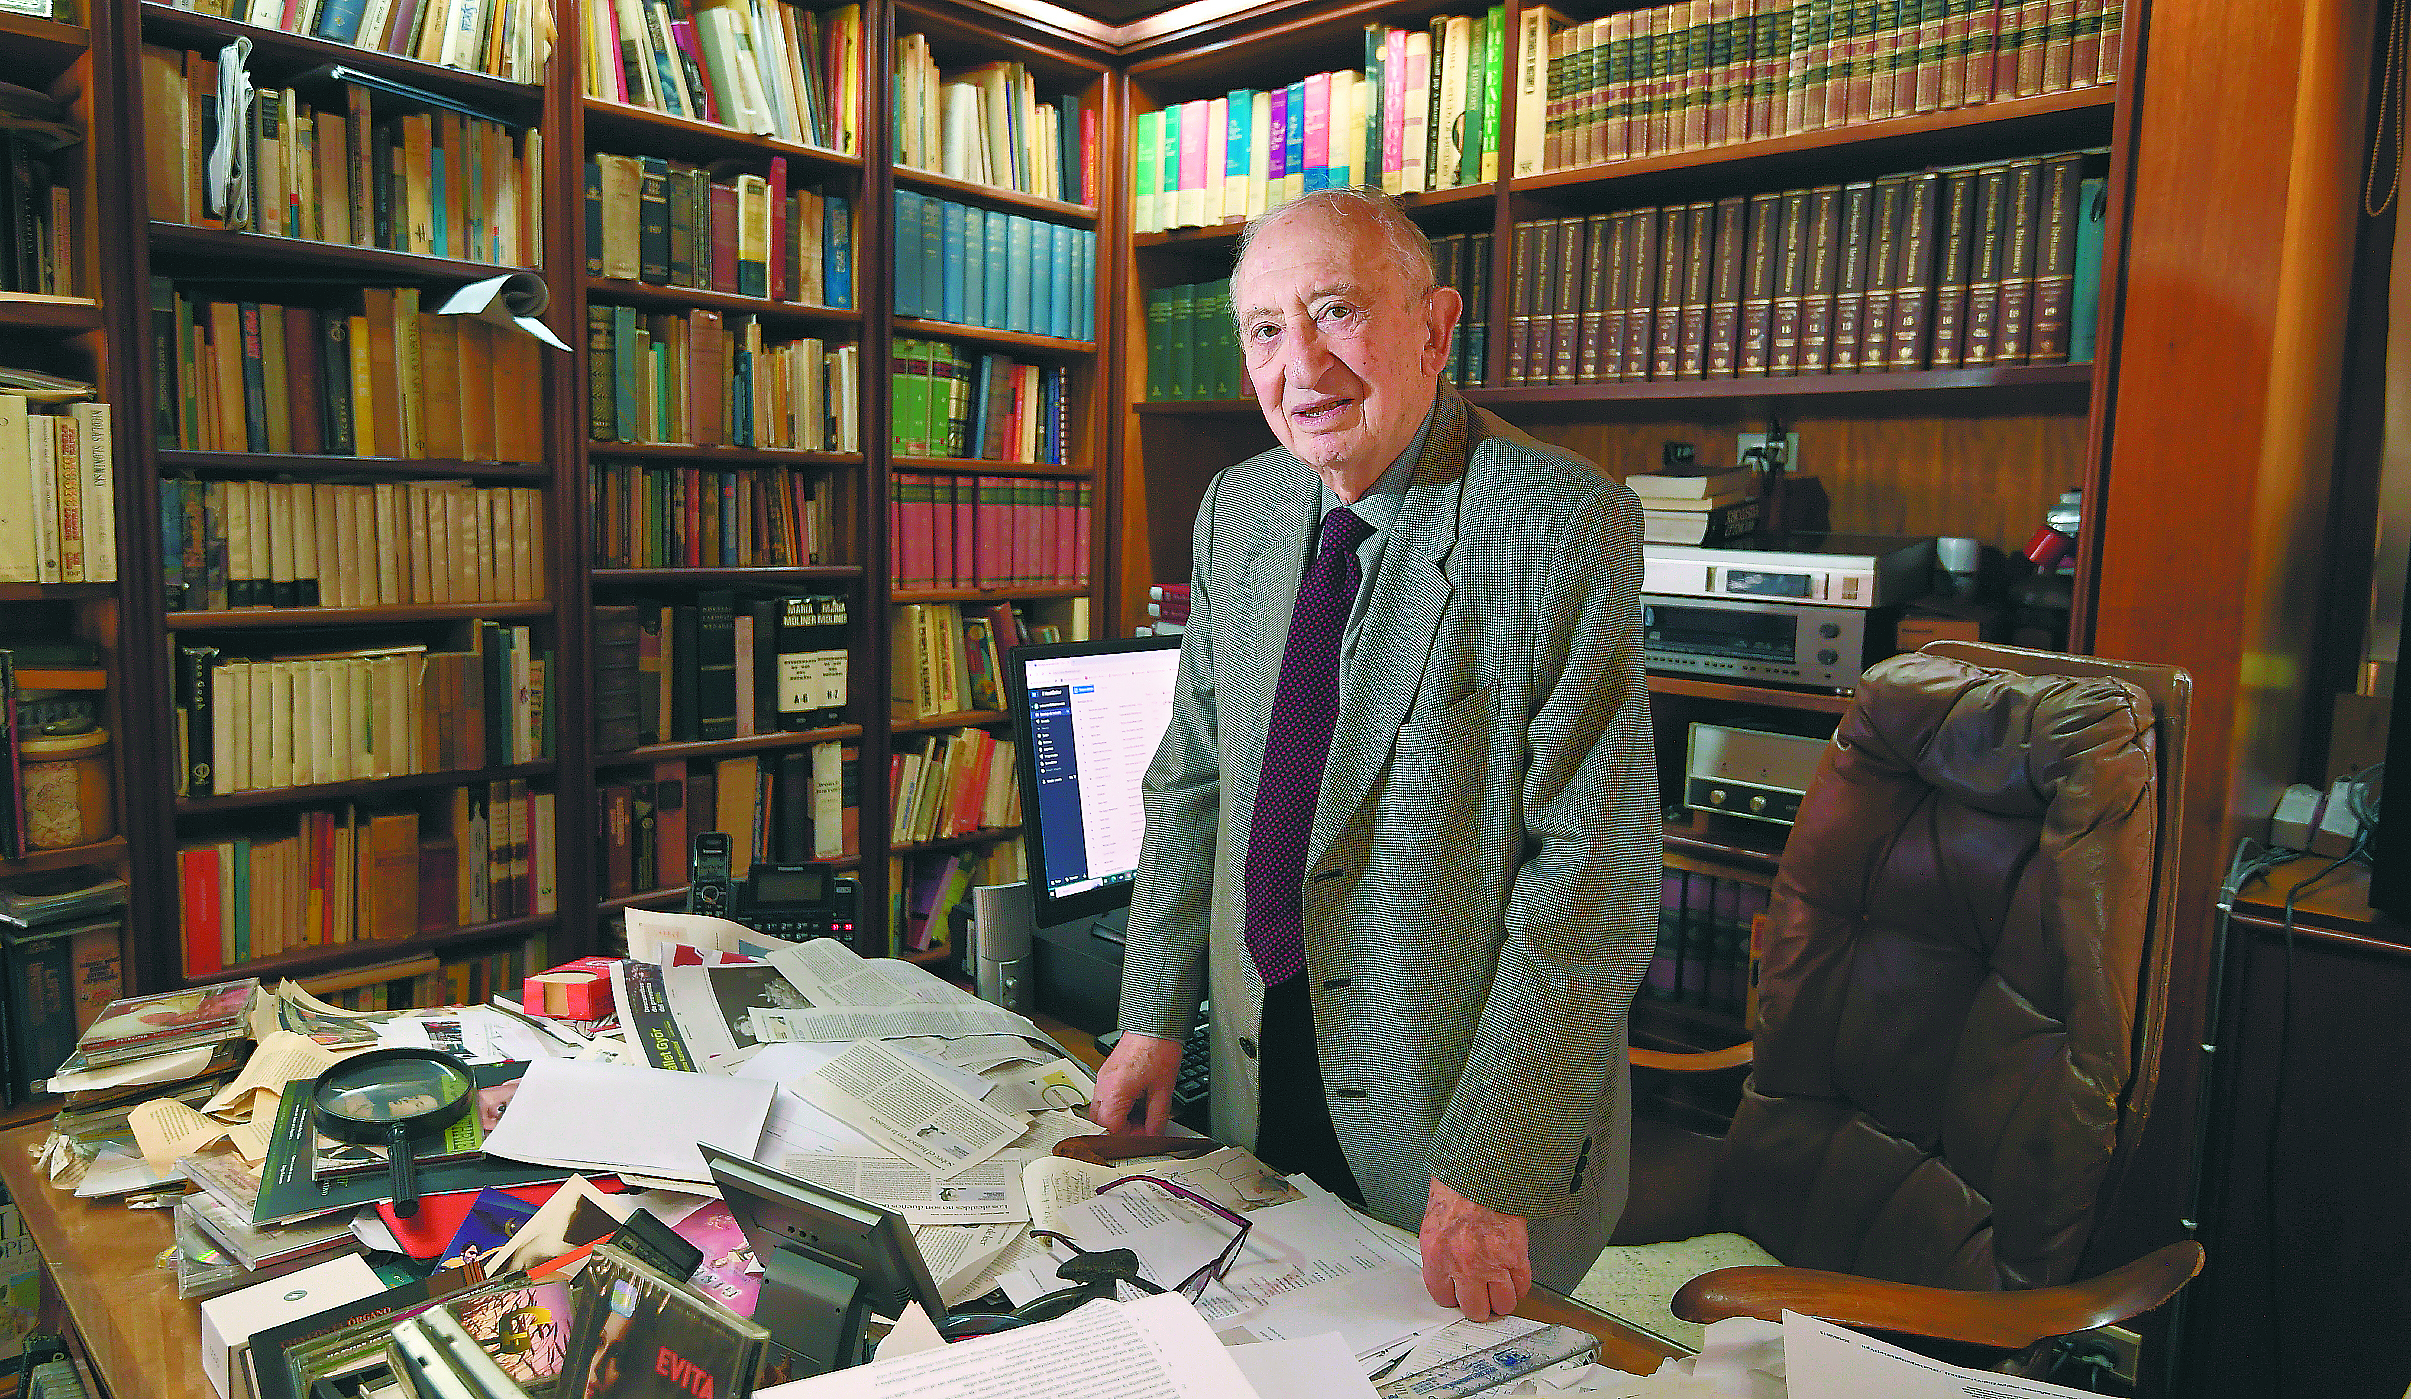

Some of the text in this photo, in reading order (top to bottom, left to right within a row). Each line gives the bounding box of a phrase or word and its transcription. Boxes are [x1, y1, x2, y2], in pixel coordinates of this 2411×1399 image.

[1482, 70, 1498, 152] EARTH
[660, 1050, 679, 1071] allet
[656, 1346, 714, 1399] EVITA
